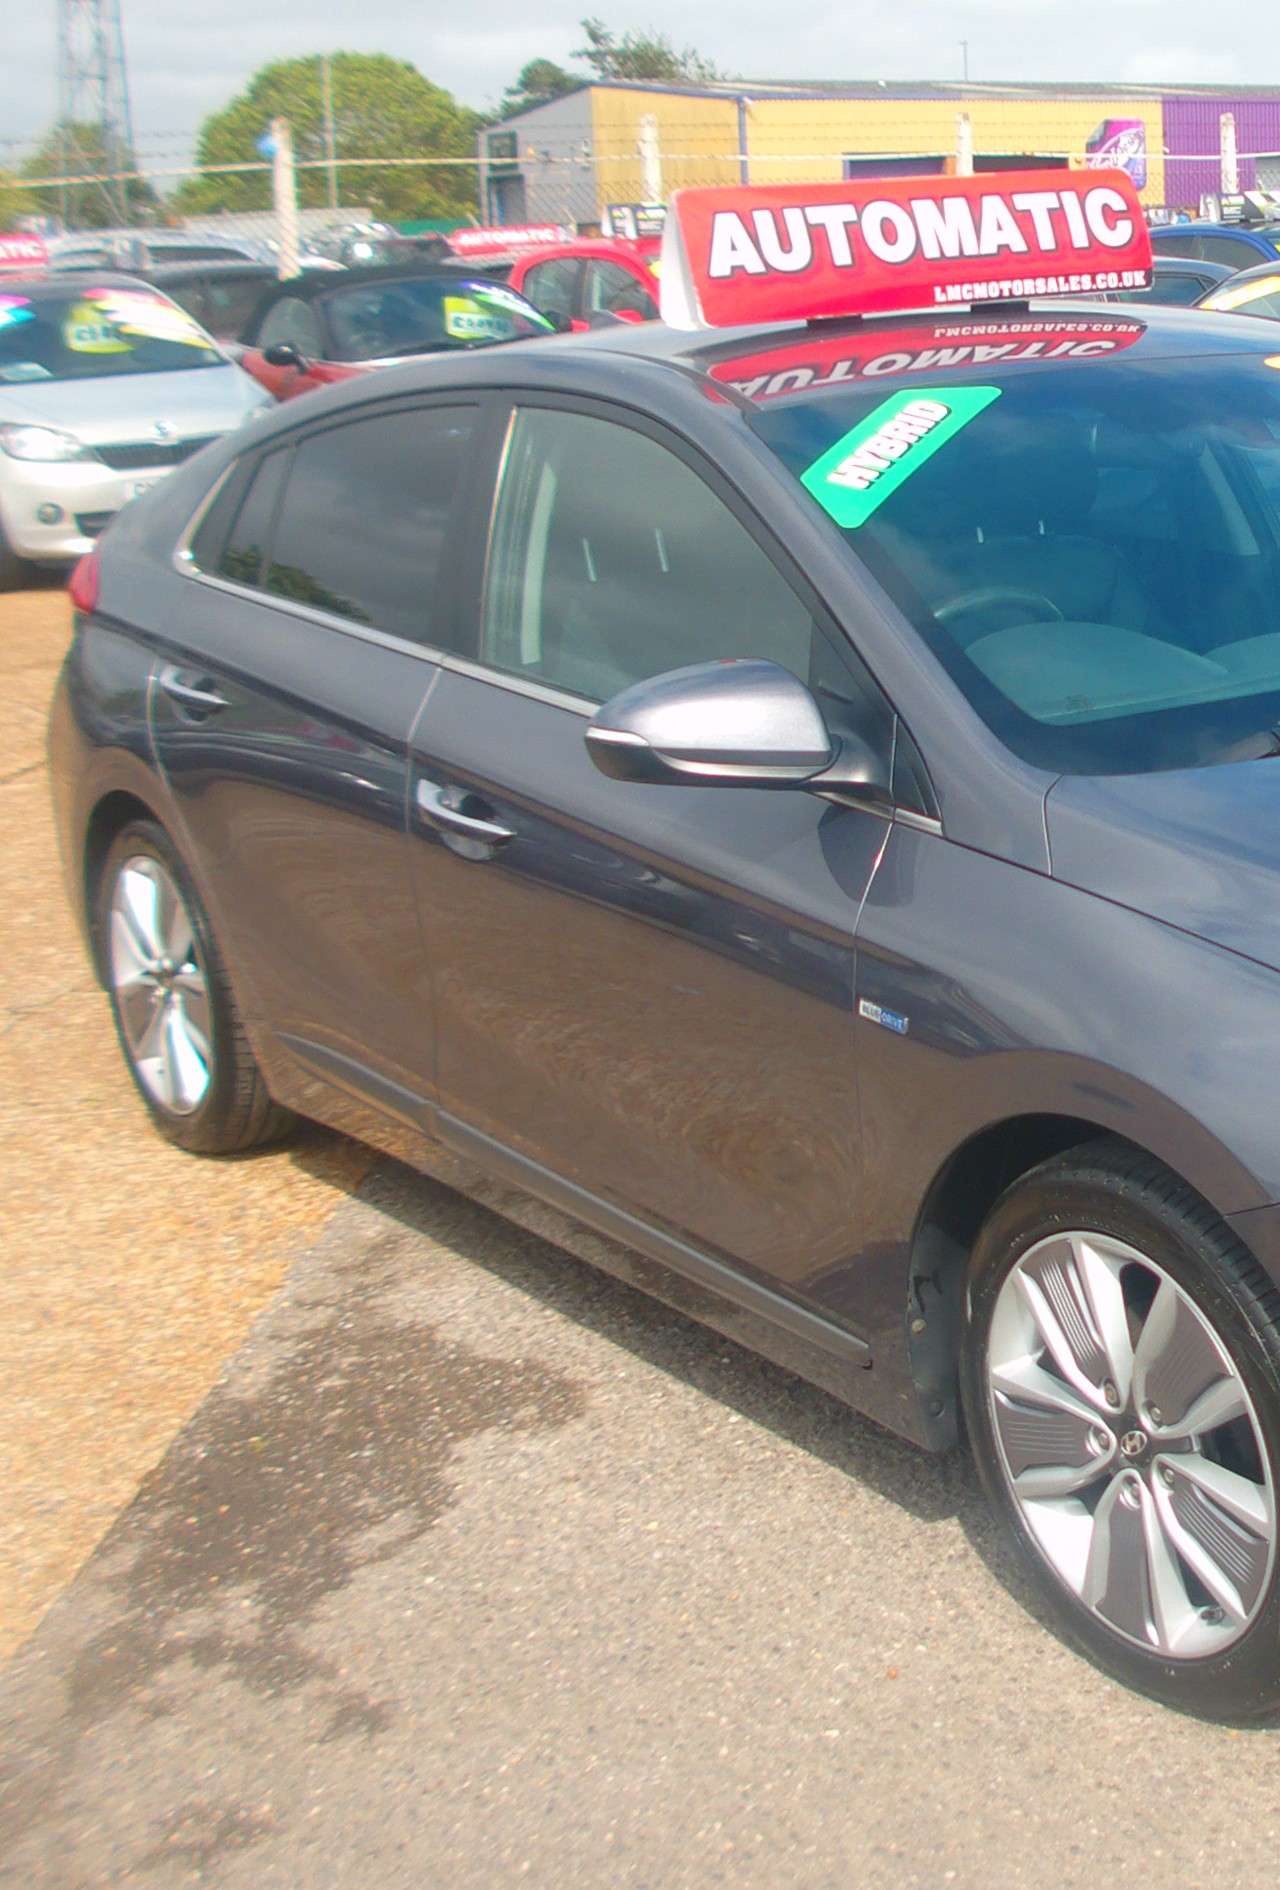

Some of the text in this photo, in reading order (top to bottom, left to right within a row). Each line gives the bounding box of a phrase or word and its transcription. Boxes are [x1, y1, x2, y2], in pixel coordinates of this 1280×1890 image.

[708, 187, 1134, 279] AUTOMATIC
[934, 270, 1147, 303] LMCMOTORSALES.CO.UK
[826, 399, 951, 491] HYBRID
